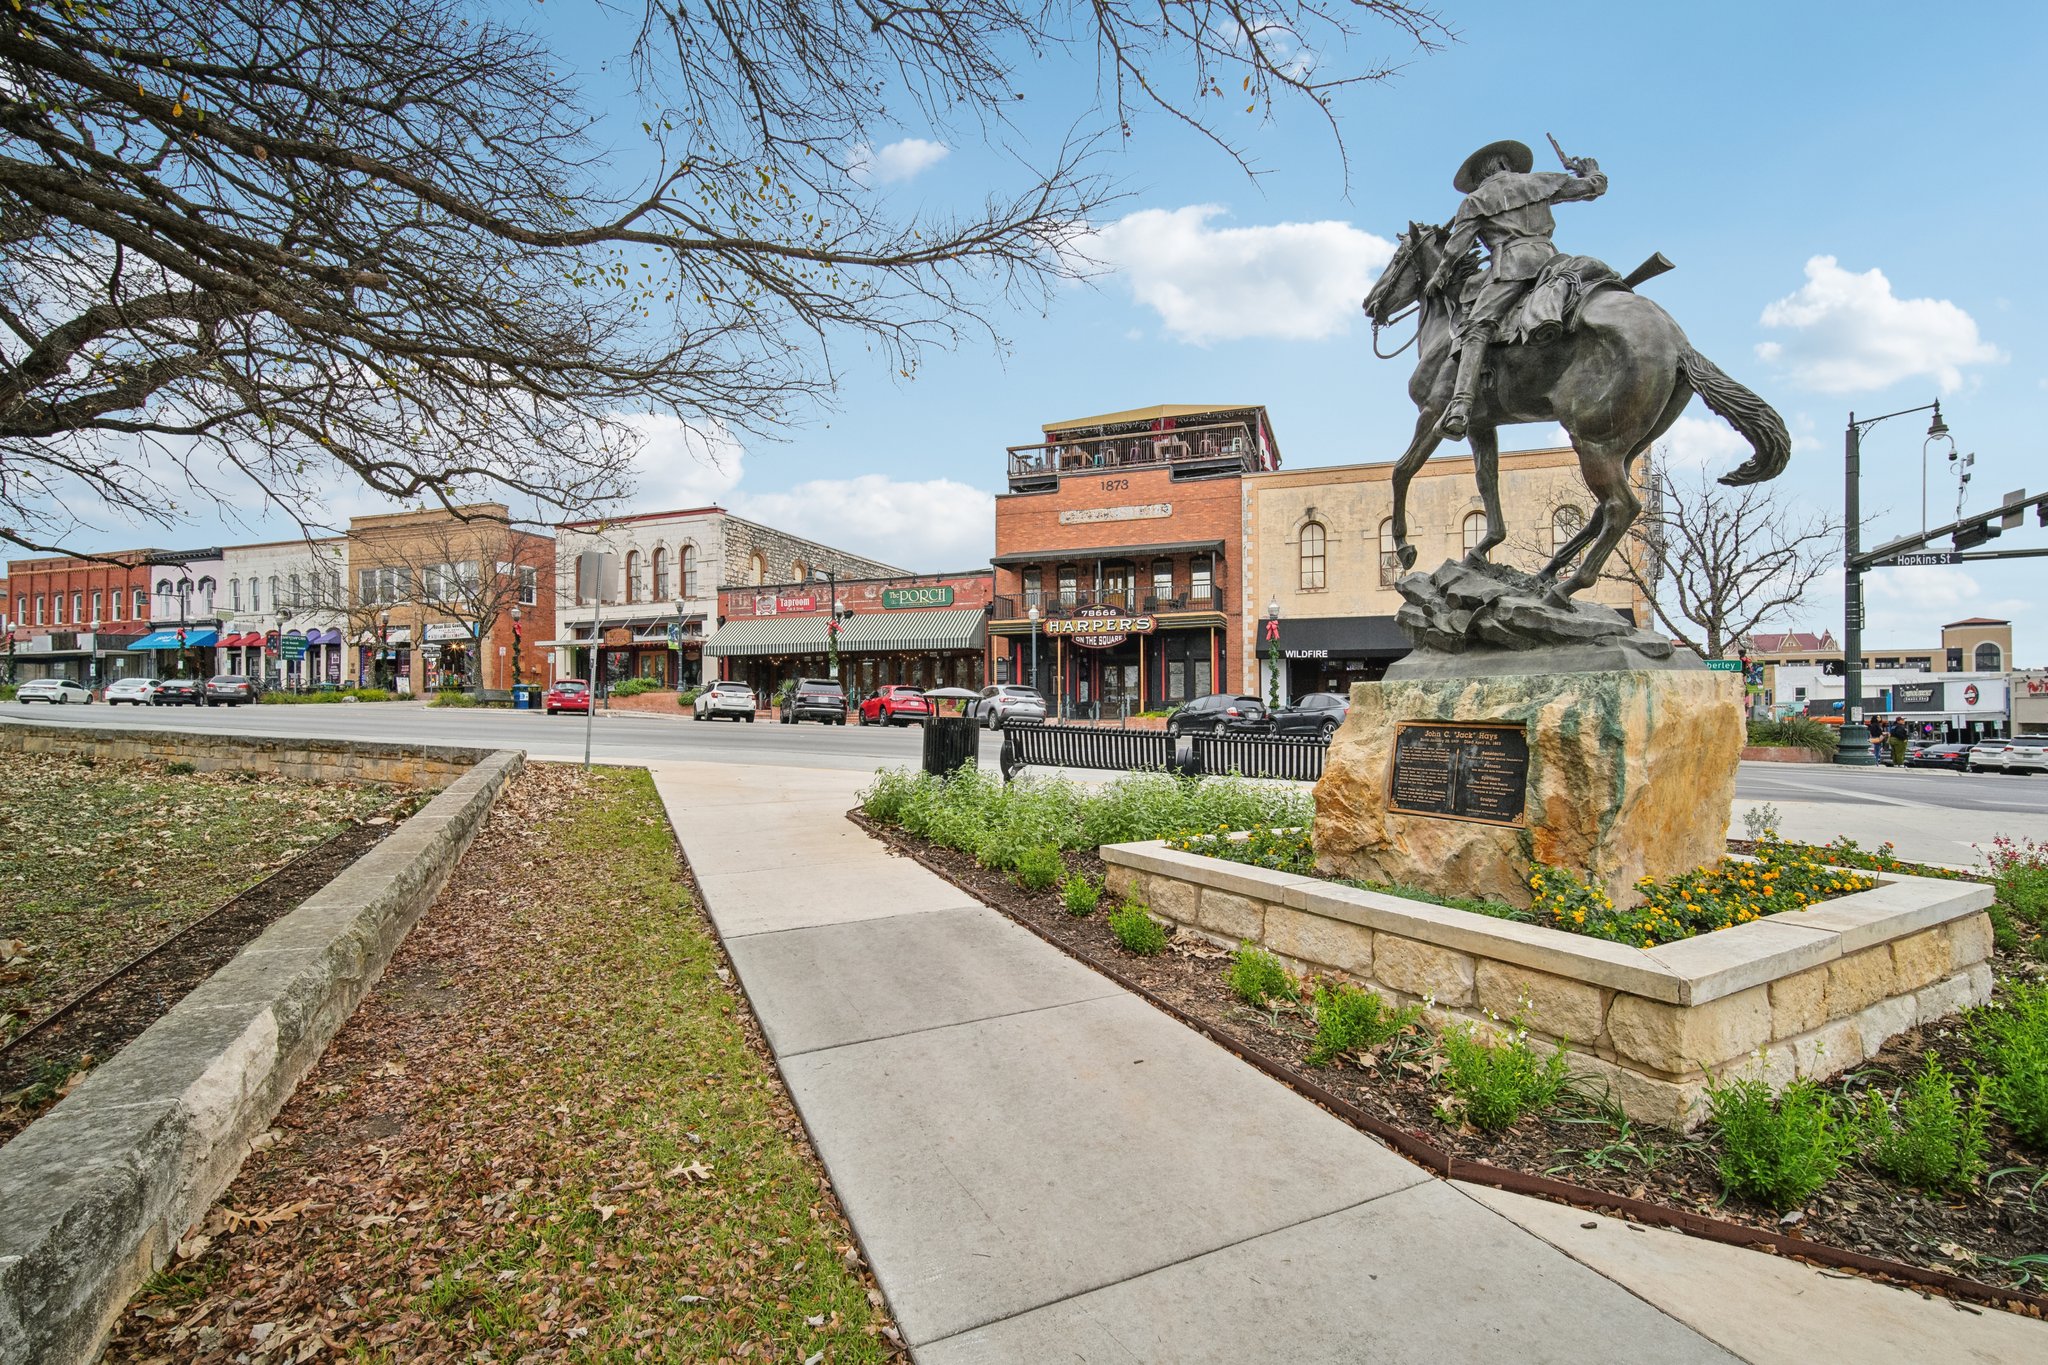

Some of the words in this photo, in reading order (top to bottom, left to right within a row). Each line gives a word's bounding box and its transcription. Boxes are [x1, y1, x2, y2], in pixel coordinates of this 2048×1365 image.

[1100, 479, 1129, 491] 1873
[1897, 554, 1937, 566] Hopkins
[1940, 553, 1951, 564] St
[889, 591, 900, 599] The
[900, 588, 946, 604] PORCH
[780, 598, 810, 608] Taproom
[1081, 609, 1117, 617] 78666
[1049, 618, 1150, 633] HARPER'S
[1085, 636, 1097, 645] THE
[1098, 635, 1123, 646] SQUARE
[1285, 650, 1328, 658] WILDFIRE
[1706, 662, 1736, 670] berley
[1424, 730, 1441, 738] John
[1479, 732, 1499, 741] Hays
